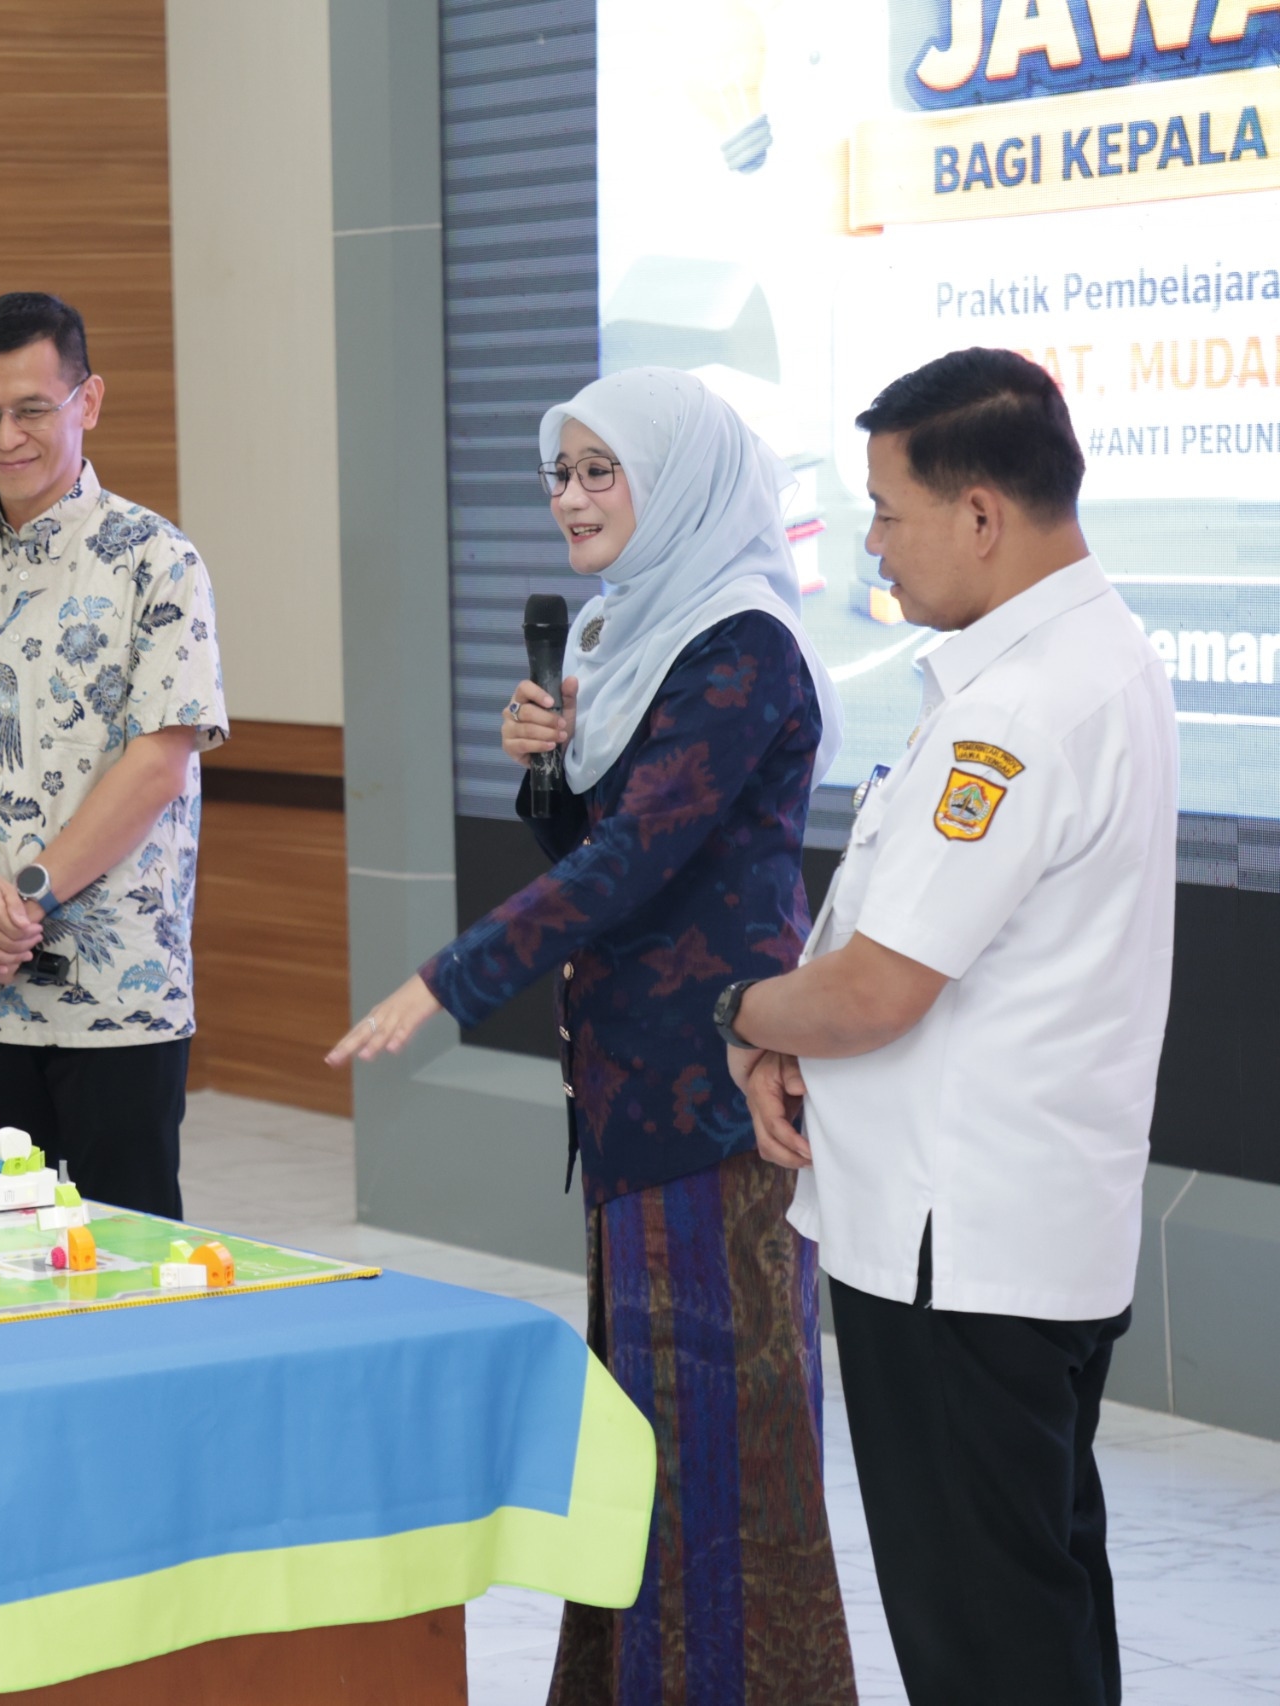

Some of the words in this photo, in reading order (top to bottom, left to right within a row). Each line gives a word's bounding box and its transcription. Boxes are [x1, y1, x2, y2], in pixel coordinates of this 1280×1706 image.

[933, 134, 1042, 194] BAGI
[1061, 105, 1269, 182] KEPALA
[936, 274, 1050, 318] Praktik
[1063, 259, 1280, 313] Pembelajara
[1016, 344, 1105, 396] AT,
[1088, 426, 1169, 456] #ANTI
[1181, 423, 1280, 454] PERUN
[1130, 614, 1280, 684] emar
